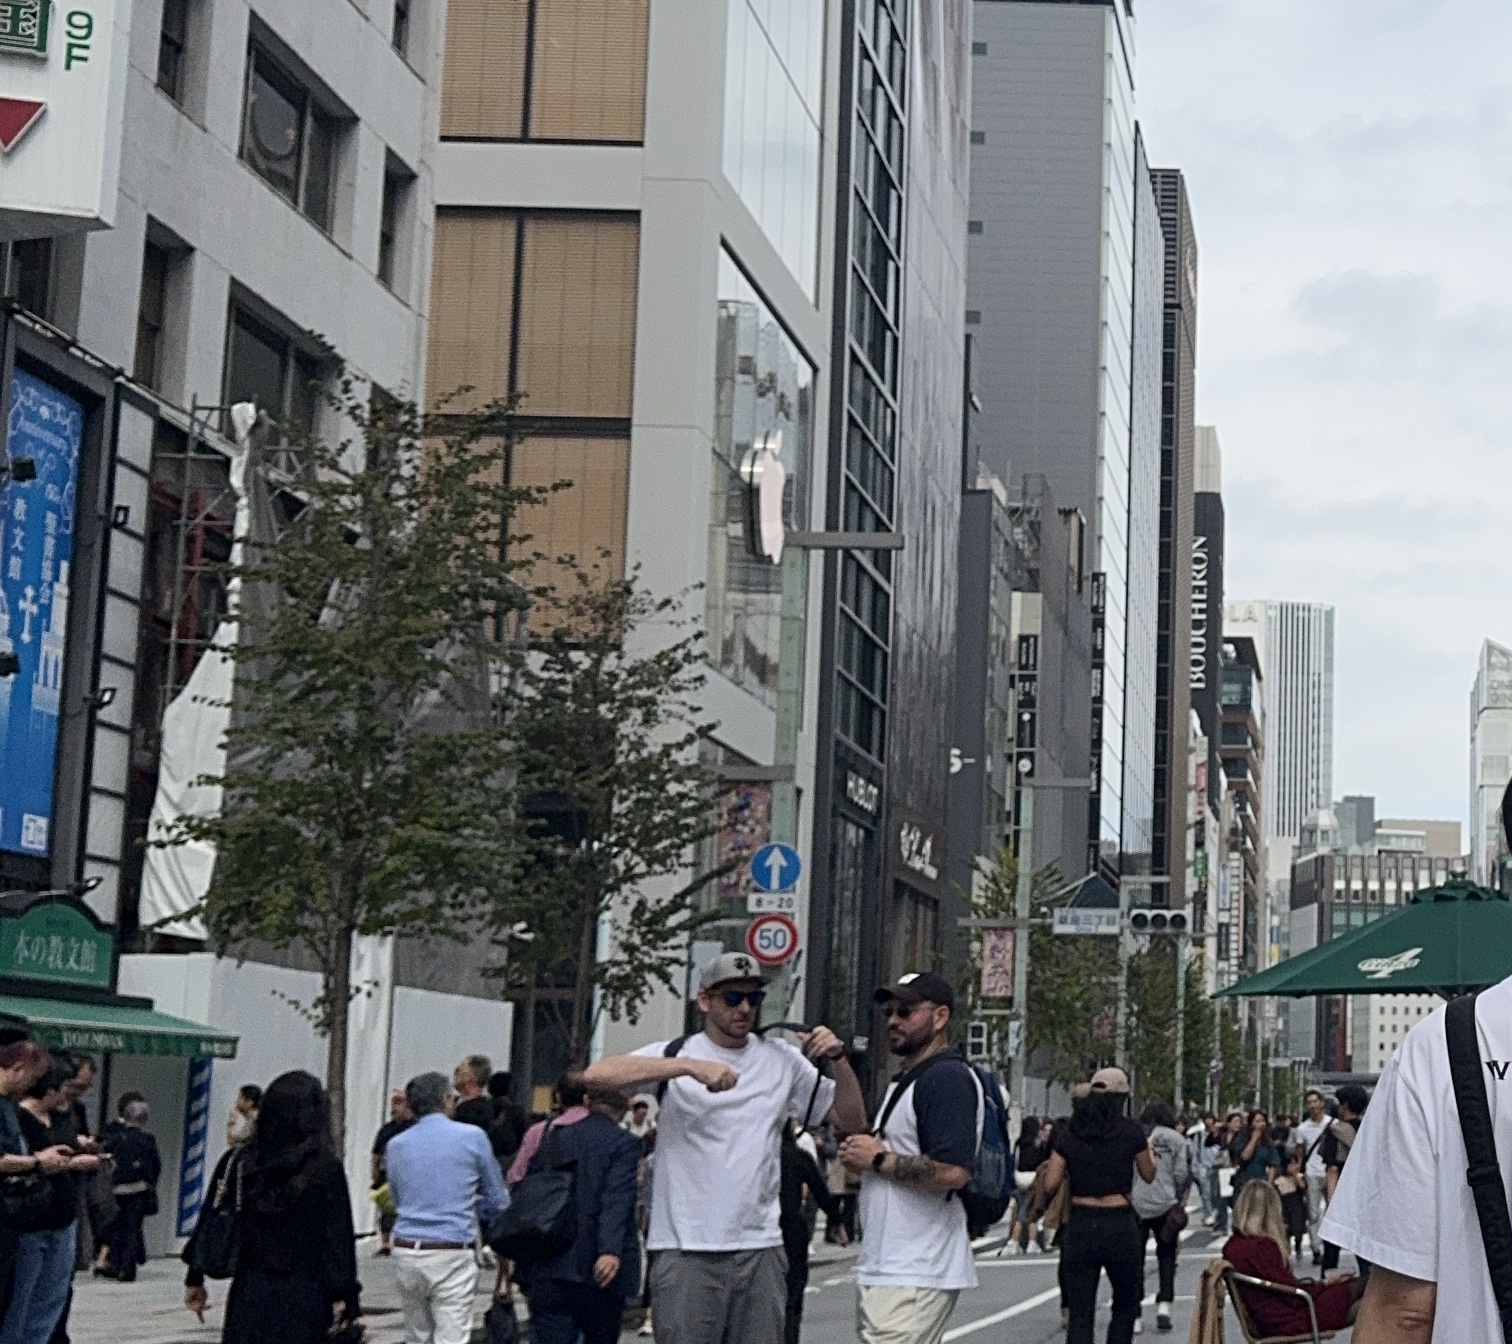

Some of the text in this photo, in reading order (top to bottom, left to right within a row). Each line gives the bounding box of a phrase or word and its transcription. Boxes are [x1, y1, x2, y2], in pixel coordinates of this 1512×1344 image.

[64, 10, 93, 71] 9F
[1189, 535, 1209, 690] BOUCHERON
[759, 928, 787, 949] 50
